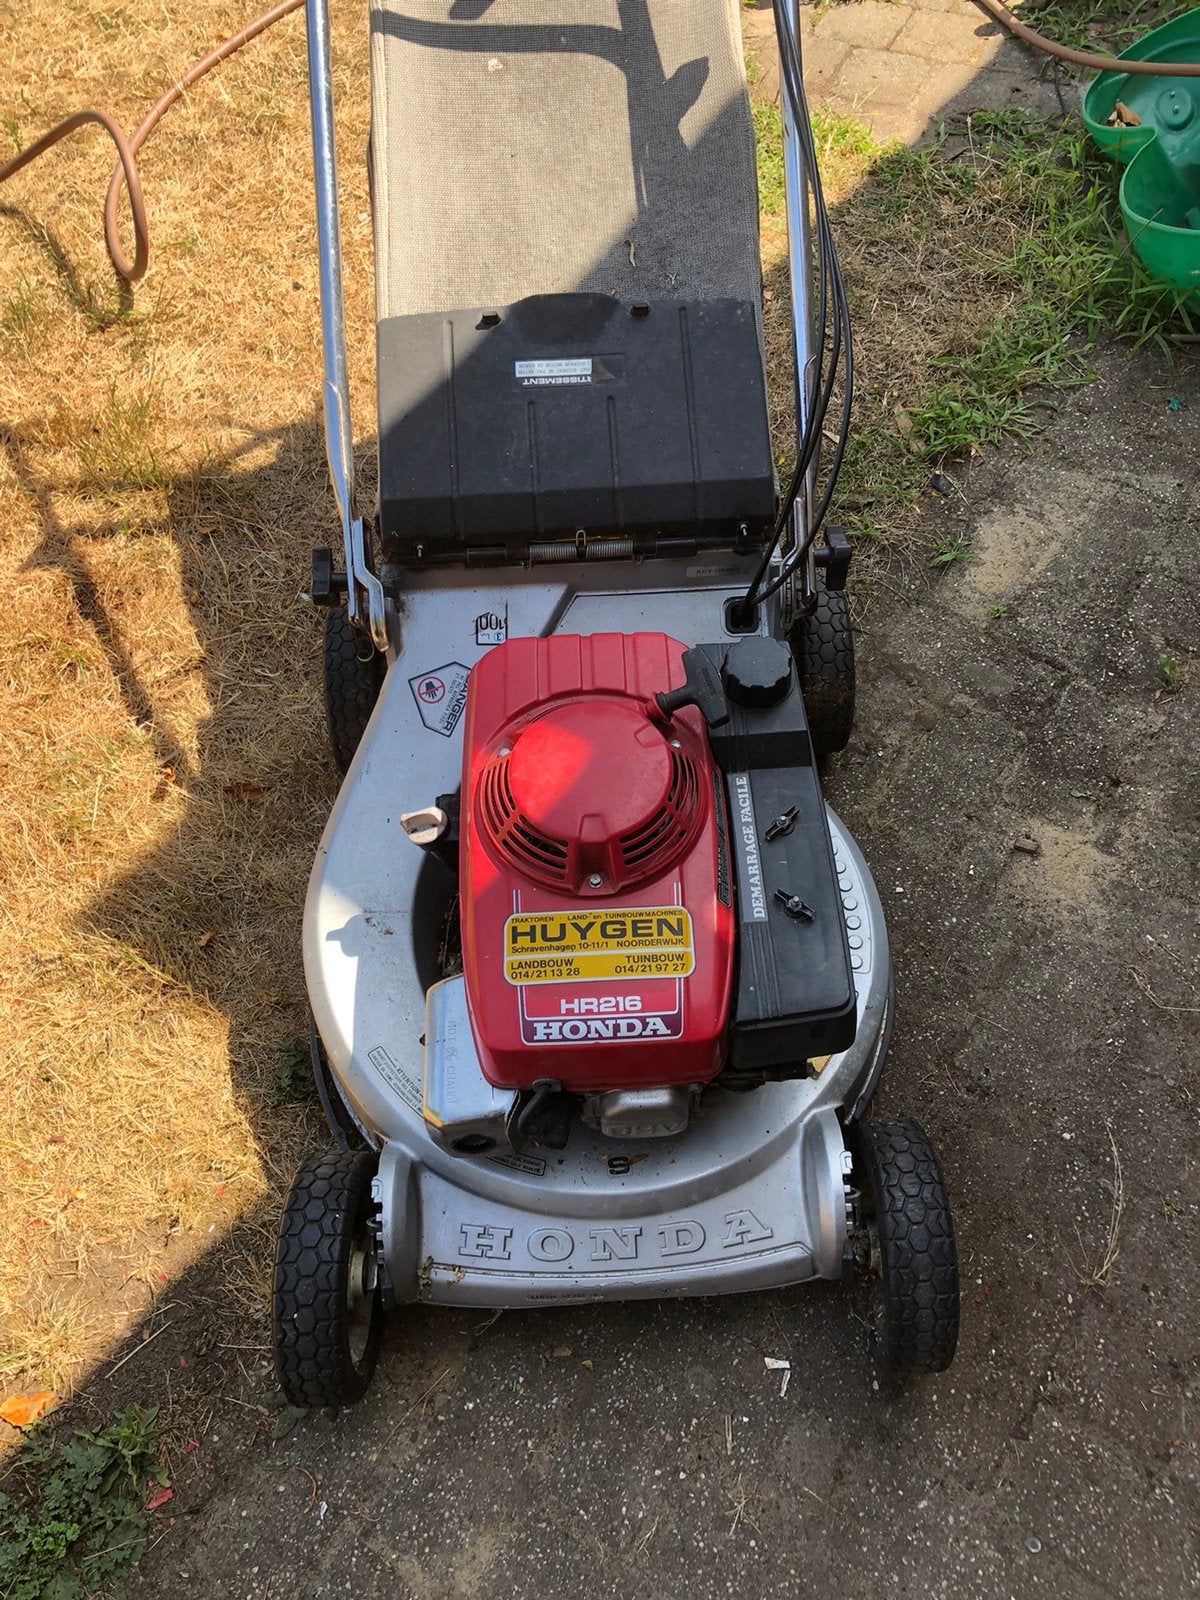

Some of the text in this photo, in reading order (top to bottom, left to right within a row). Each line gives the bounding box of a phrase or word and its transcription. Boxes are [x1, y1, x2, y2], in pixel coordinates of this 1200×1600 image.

[443, 677, 468, 732] ANGER
[736, 776, 766, 919] DEMARRAGE FACILE
[511, 916, 554, 924] TRAKTOREN
[511, 918, 684, 945] HUYGEN
[511, 938, 685, 954] Schravenhagen 10-11/1 NOORDERWIJK
[511, 958, 574, 970] LANDBOUW
[625, 953, 685, 964] TUINBOUW
[511, 967, 580, 980] 014/21 13 28
[614, 962, 686, 974] 014/21 97 27
[560, 995, 642, 1014] HR216
[533, 1016, 672, 1041] HONDA
[458, 1209, 774, 1262] HONDA
